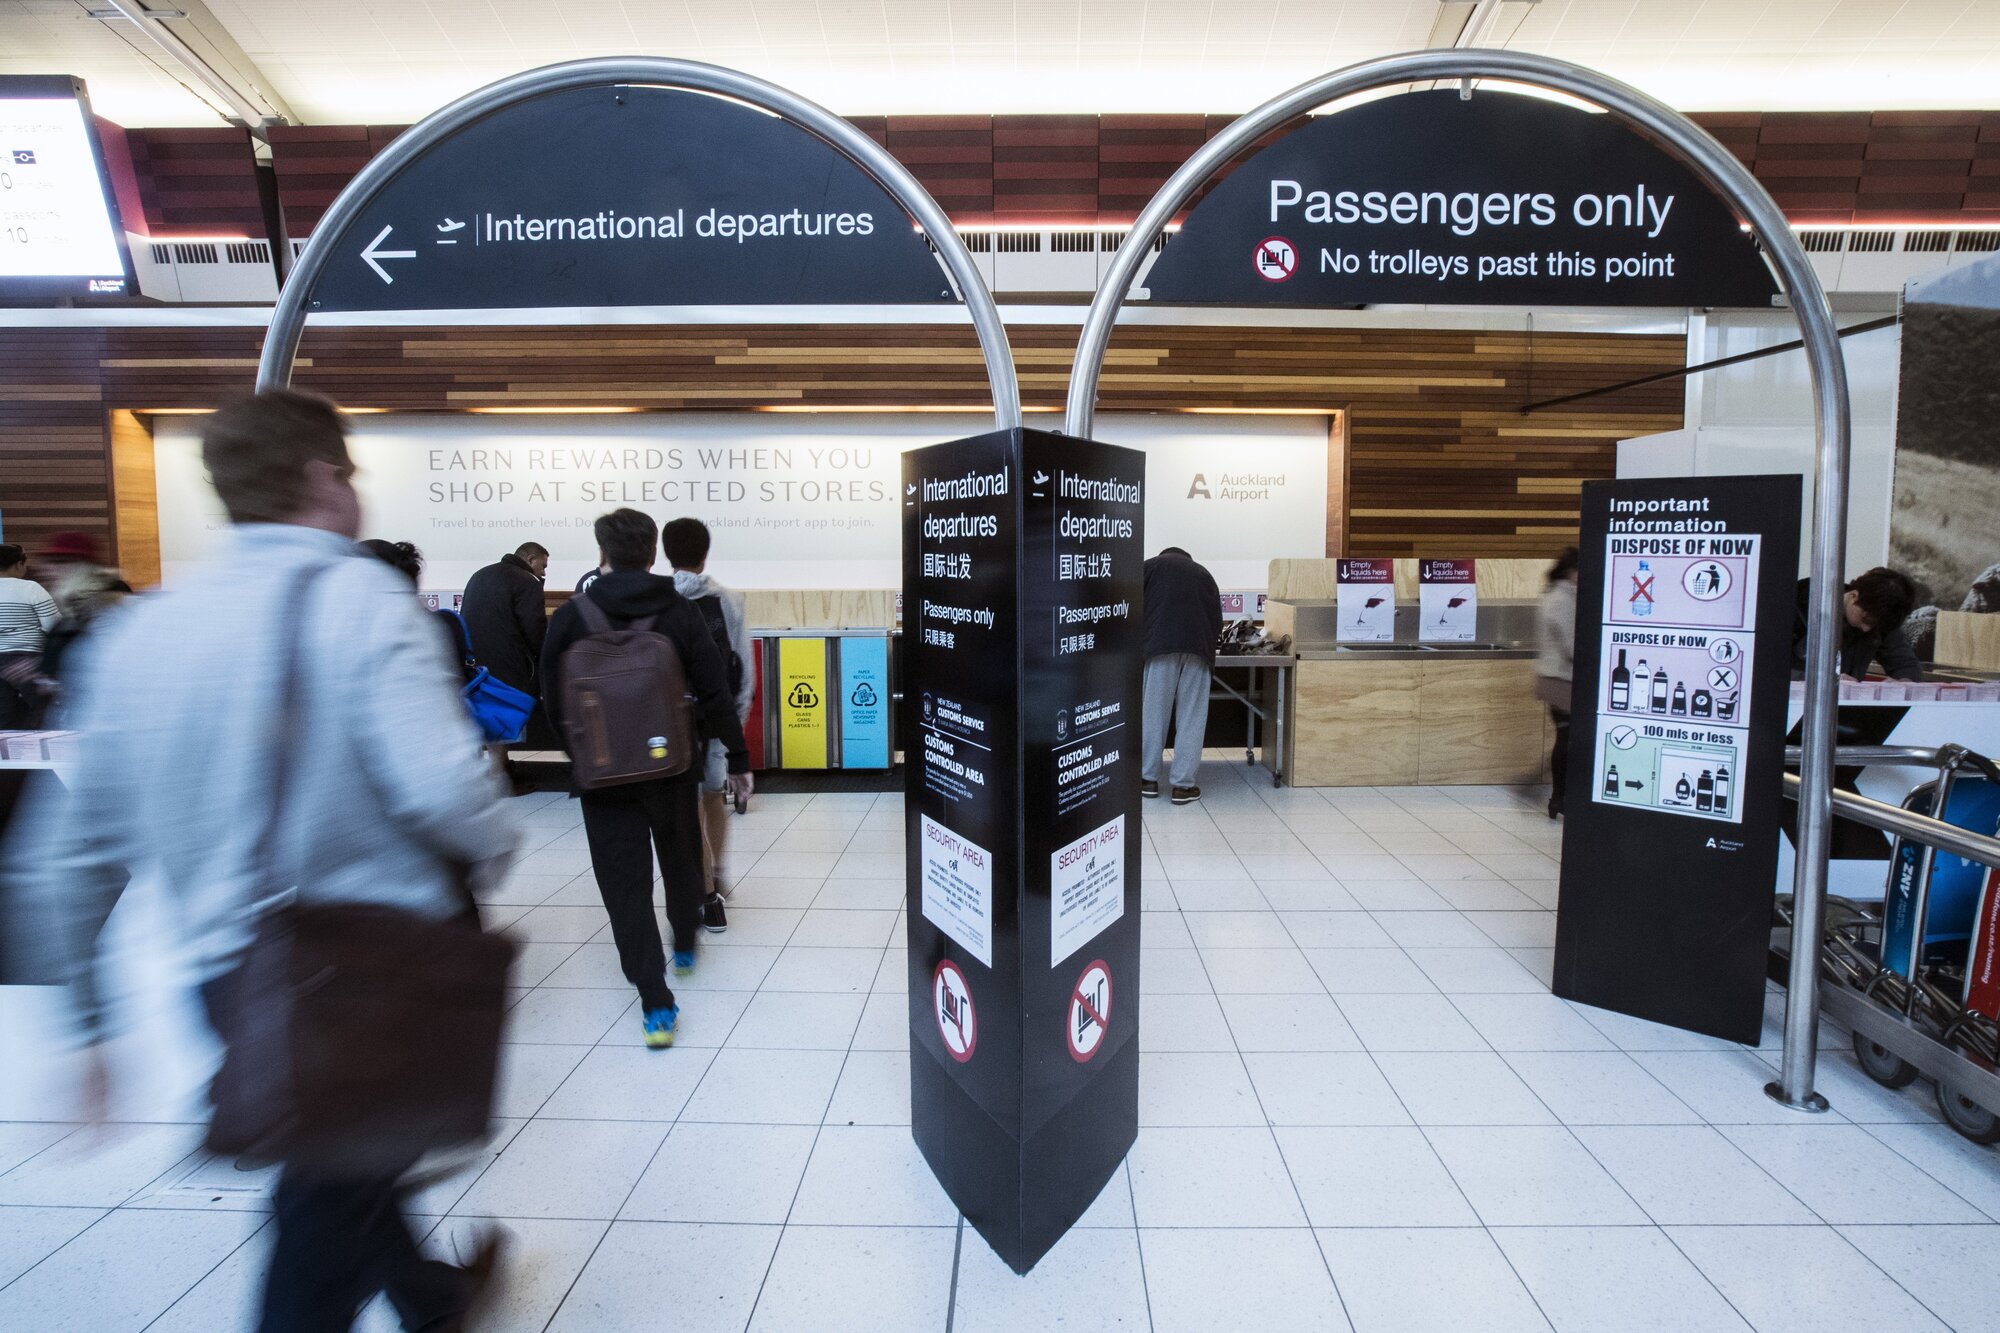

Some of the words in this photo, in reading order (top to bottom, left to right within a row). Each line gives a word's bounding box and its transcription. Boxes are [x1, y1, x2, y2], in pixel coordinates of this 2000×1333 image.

[1270, 180, 1556, 235] Passengers
[1573, 184, 1675, 238] only
[7, 227, 28, 243] 10
[486, 209, 683, 242] International
[695, 208, 874, 243] departures
[1320, 248, 1360, 273] No
[1368, 249, 1469, 281] trolleys
[1478, 253, 1538, 281] past
[1546, 251, 1596, 277] this
[1605, 252, 1675, 283] point
[429, 449, 512, 471] EARN
[529, 448, 683, 470] REWARDS
[697, 448, 792, 470] WHEN
[808, 448, 871, 470] YOU
[924, 465, 1008, 502] International
[1060, 469, 1141, 504] International
[1220, 473, 1285, 486] Auckland
[429, 481, 514, 503] SHOP
[528, 481, 566, 502] AT
[580, 480, 746, 502] SELECTED
[759, 480, 894, 502] STORES.
[1220, 487, 1269, 503] Airport
[1609, 497, 1710, 515] Important
[430, 517, 468, 528] Travel
[471, 518, 484, 528] to
[487, 517, 537, 528] another
[541, 517, 571, 528] level.
[703, 517, 750, 528] uckland
[754, 517, 801, 530] Airport
[804, 519, 828, 530] app
[832, 518, 844, 528] to
[846, 517, 874, 530] join.
[924, 512, 997, 544] departures
[1060, 509, 1133, 544] departures
[1609, 517, 1727, 533] information
[1611, 538, 1681, 555] DISPOSE
[1685, 538, 1706, 555] OF
[1709, 539, 1754, 556] NOW
[923, 553, 972, 580] 国际出发
[1059, 552, 1112, 581] 国际出发
[1350, 561, 1371, 569] Empty
[1350, 568, 1371, 577] liquids
[1372, 568, 1388, 576] here
[1432, 561, 1454, 569] Empty
[1432, 568, 1454, 577] liquids
[1454, 568, 1469, 576] here
[923, 600, 972, 625] Passengers
[973, 606, 995, 630] only
[1059, 604, 1112, 624] Passengers
[1112, 599, 1130, 619] only
[924, 628, 955, 649] 只限乘客
[1059, 632, 1095, 655] 只限乘客
[1612, 631, 1660, 645] DISPOSE
[1662, 634, 1678, 646] OF
[1678, 635, 1708, 648] NOW
[937, 707, 962, 724] CUSTOMS
[962, 715, 985, 731] SERVICE
[1075, 704, 1085, 714] NEW
[1075, 709, 1101, 726] CUSTOMS
[1101, 702, 1121, 717] SERVICE
[924, 734, 954, 756] CUSTOMS
[1643, 725, 1664, 737] 100
[1666, 728, 1689, 740] mls
[1691, 731, 1705, 742] or
[1706, 731, 1734, 745] less
[924, 749, 964, 776] CONTROLLED
[965, 767, 985, 786] AREA
[1058, 745, 1093, 769] CUSTOMS
[1058, 757, 1102, 786] CONTROLLED
[1102, 749, 1120, 767] AREA
[926, 823, 961, 855] SECURITY
[963, 846, 985, 871] AREA
[1058, 834, 1098, 870] SECURITY
[1099, 824, 1119, 847] AREA
